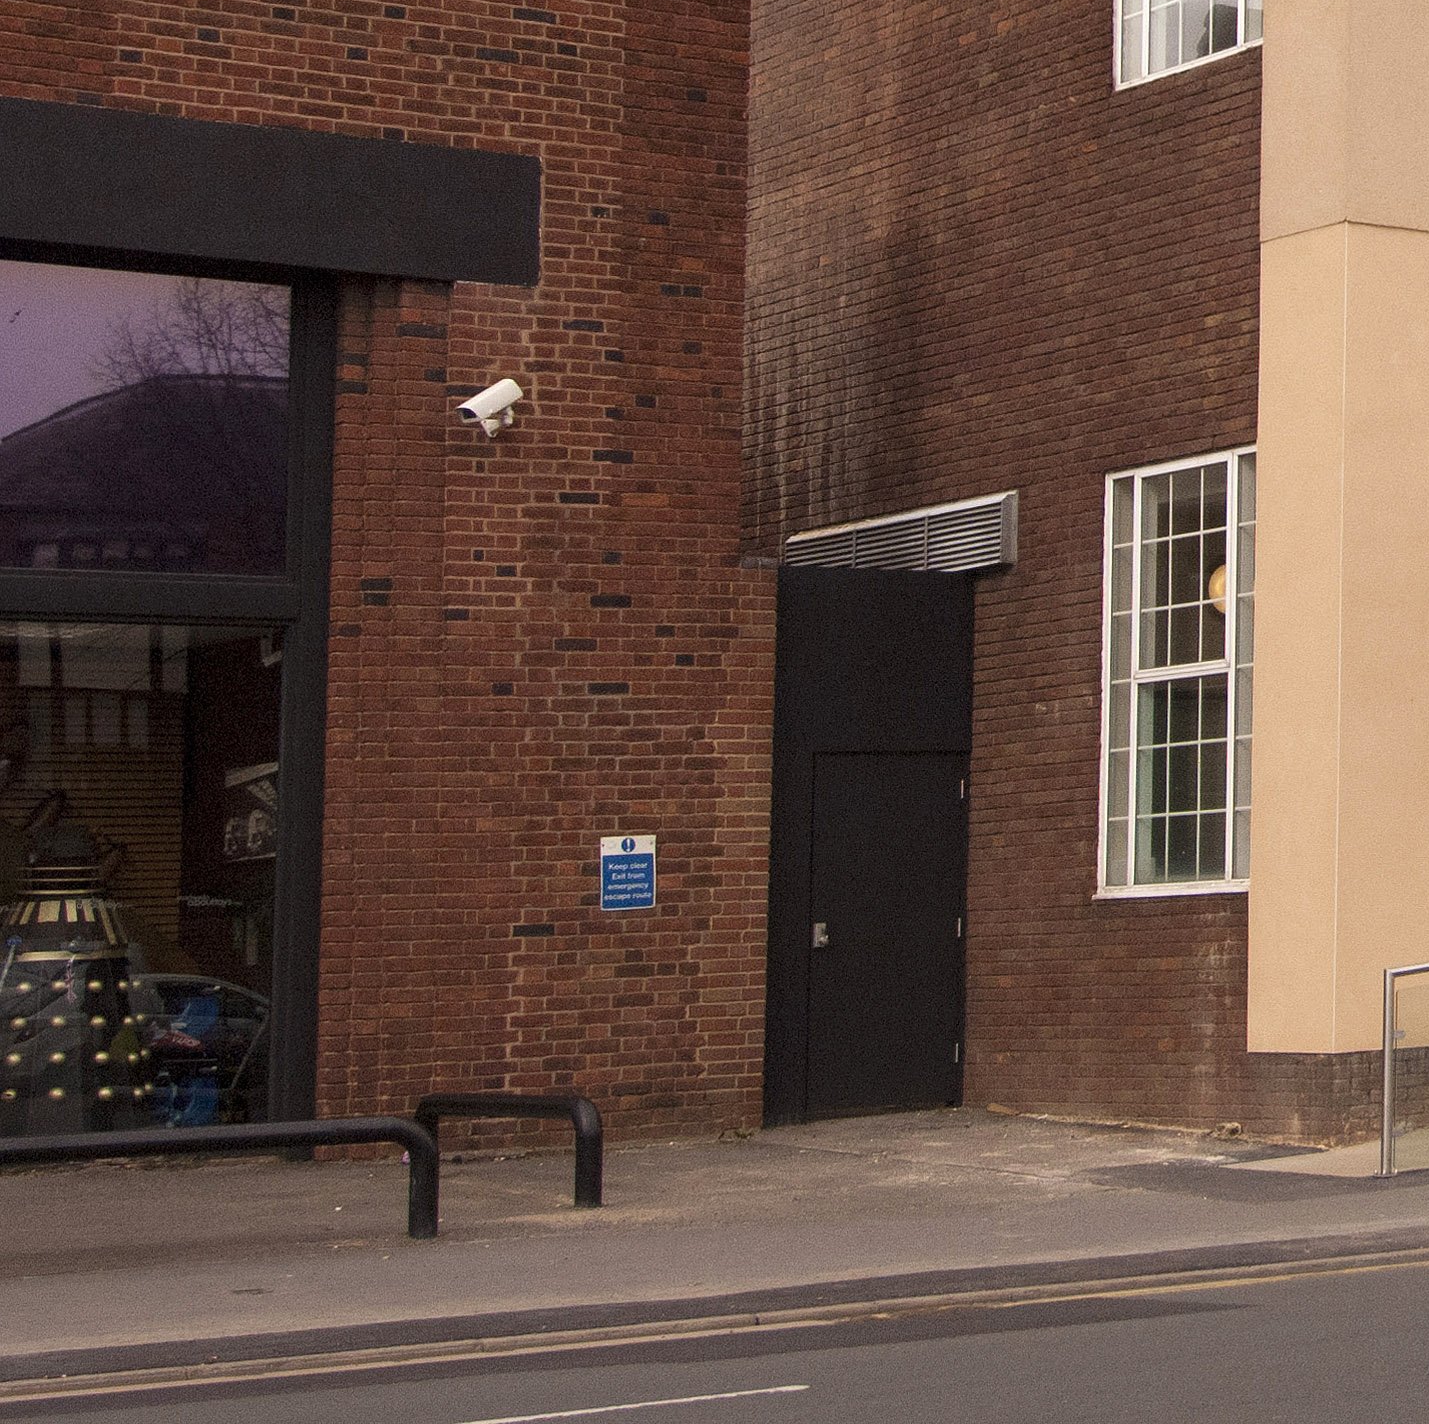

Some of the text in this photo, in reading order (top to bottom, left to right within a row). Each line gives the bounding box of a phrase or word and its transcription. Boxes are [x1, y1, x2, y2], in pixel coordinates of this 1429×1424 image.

[608, 863, 628, 871] Keep
[612, 872, 646, 880] Exit from
